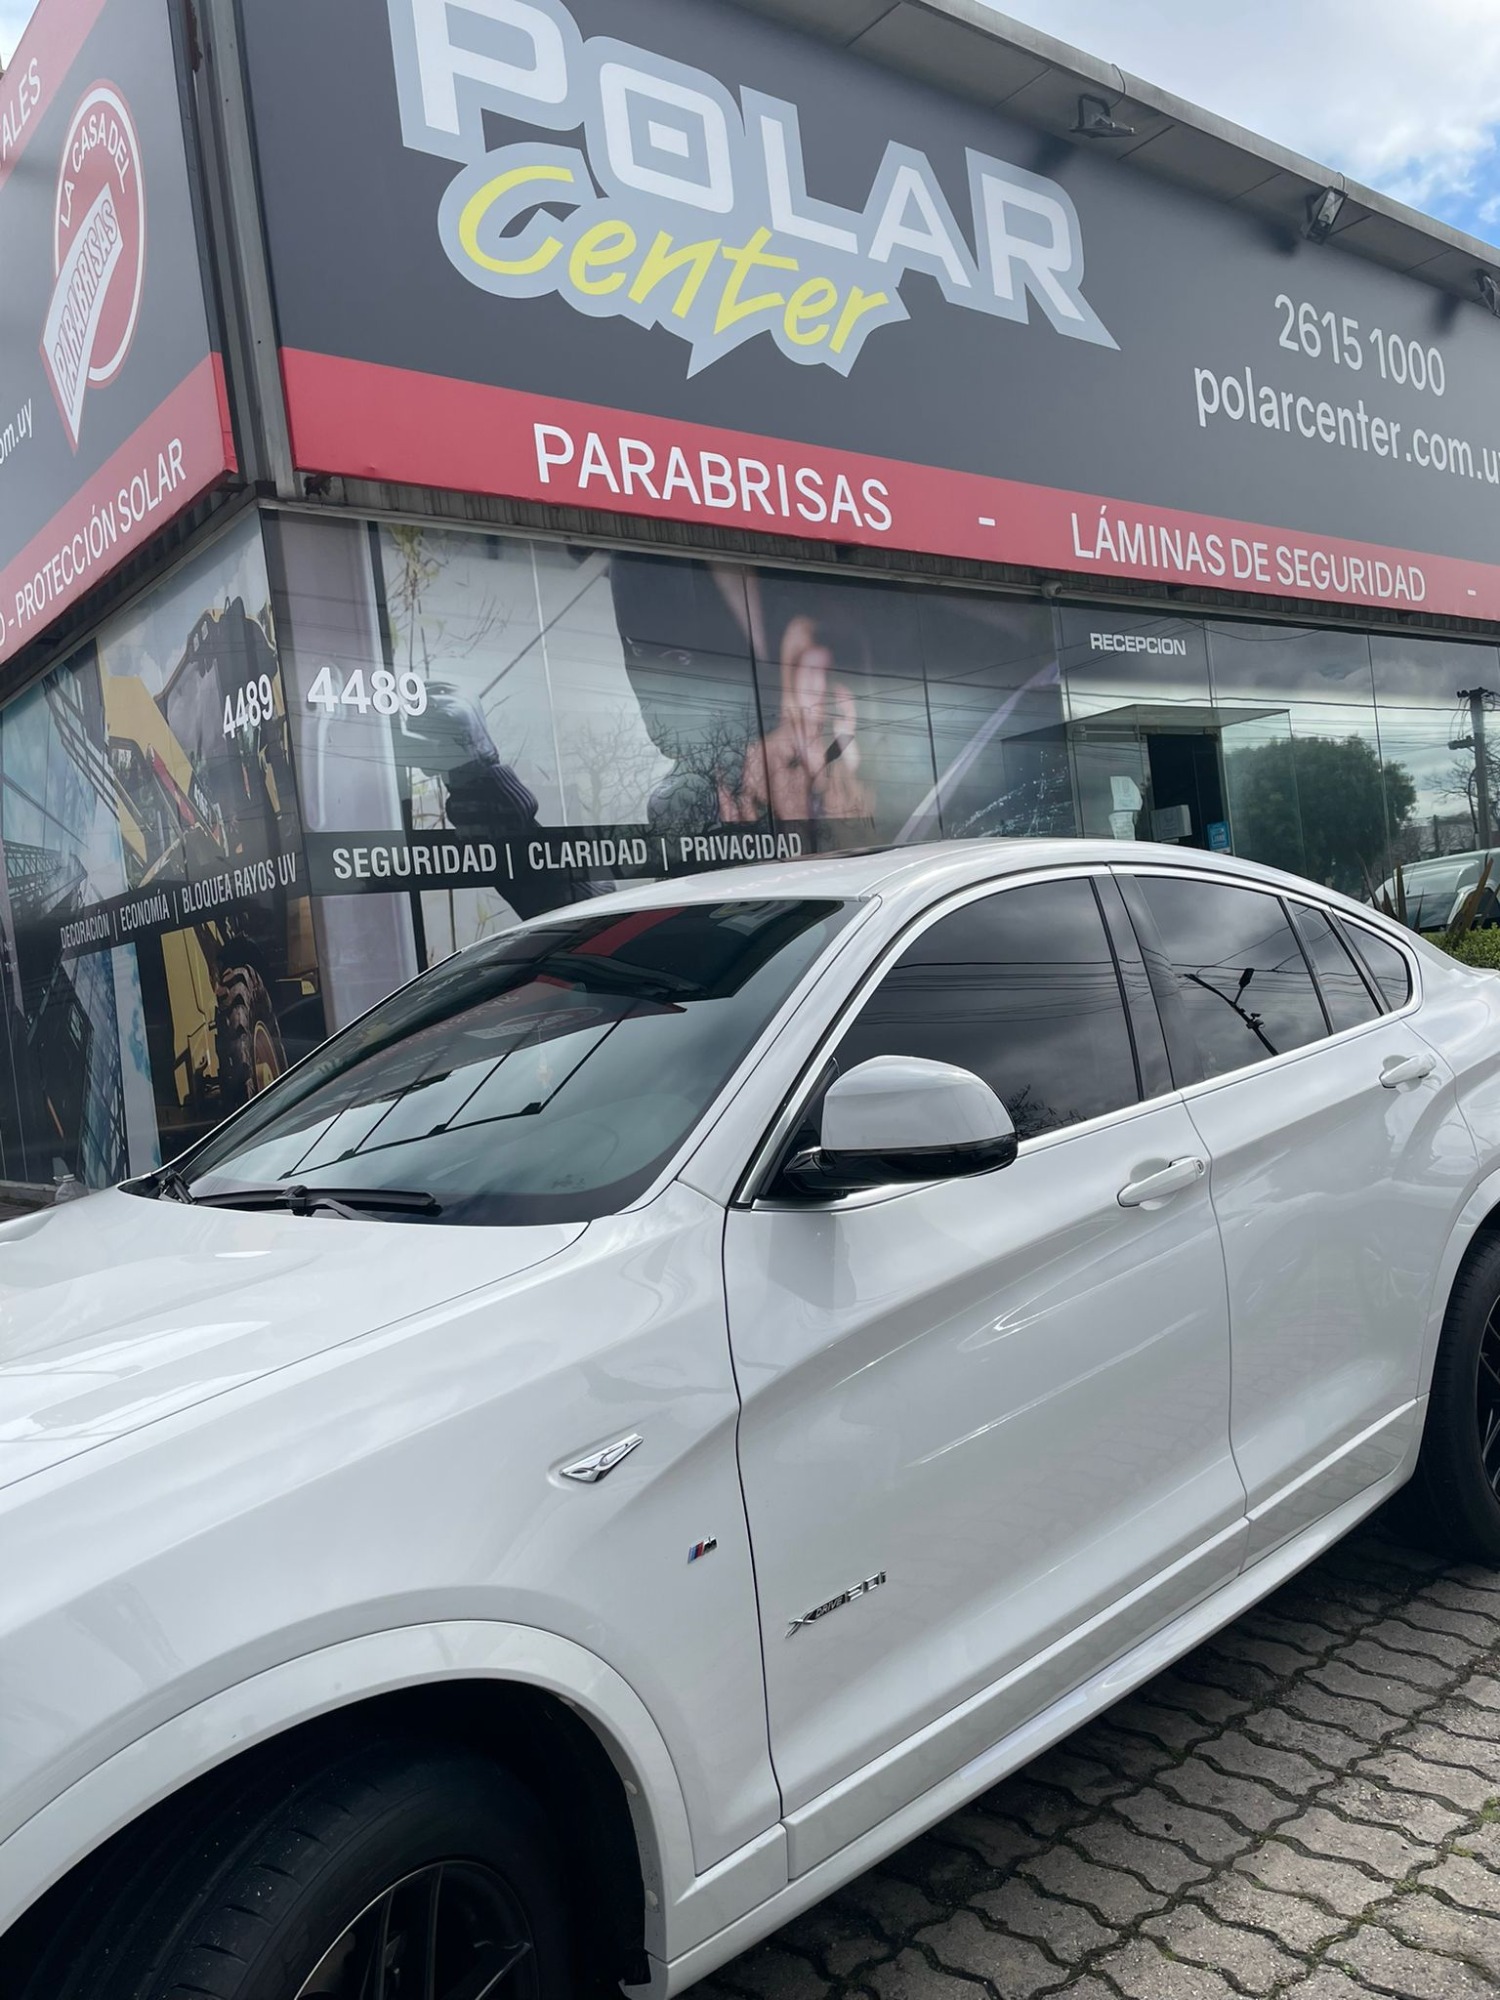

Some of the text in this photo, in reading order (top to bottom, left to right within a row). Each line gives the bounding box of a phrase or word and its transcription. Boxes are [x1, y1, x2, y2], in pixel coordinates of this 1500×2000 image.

[0, 57, 41, 162] ALES
[410, 0, 1086, 323] POLAR
[61, 112, 130, 229] LA CASA DEL
[53, 198, 119, 418] PARABRISAS
[458, 164, 890, 354] Center
[1274, 293, 1446, 397] 2615 1000
[1193, 365, 1500, 485] polarcenter.com.u
[15, 503, 118, 629] PROTECCIÓN
[117, 437, 187, 534] SOLAR
[532, 422, 893, 532] PARABRISAS
[1070, 505, 1226, 577] LÁMINAS
[1231, 538, 1271, 584] DE
[1276, 545, 1427, 602] SEGURIDAD
[307, 666, 428, 717] 4489
[1089, 632, 1187, 656] RECEPCION
[222, 673, 274, 739] 4489
[59, 908, 111, 950] DECORACIÓN
[119, 887, 171, 932] ECONOMÍA
[181, 872, 233, 915] BLOQUEA
[233, 859, 276, 899] RAYOS
[277, 851, 298, 889] UV
[332, 843, 498, 880] SEGURIDAD
[527, 837, 649, 871] CLARIDAD
[679, 832, 802, 863] PRIVACIDAD
